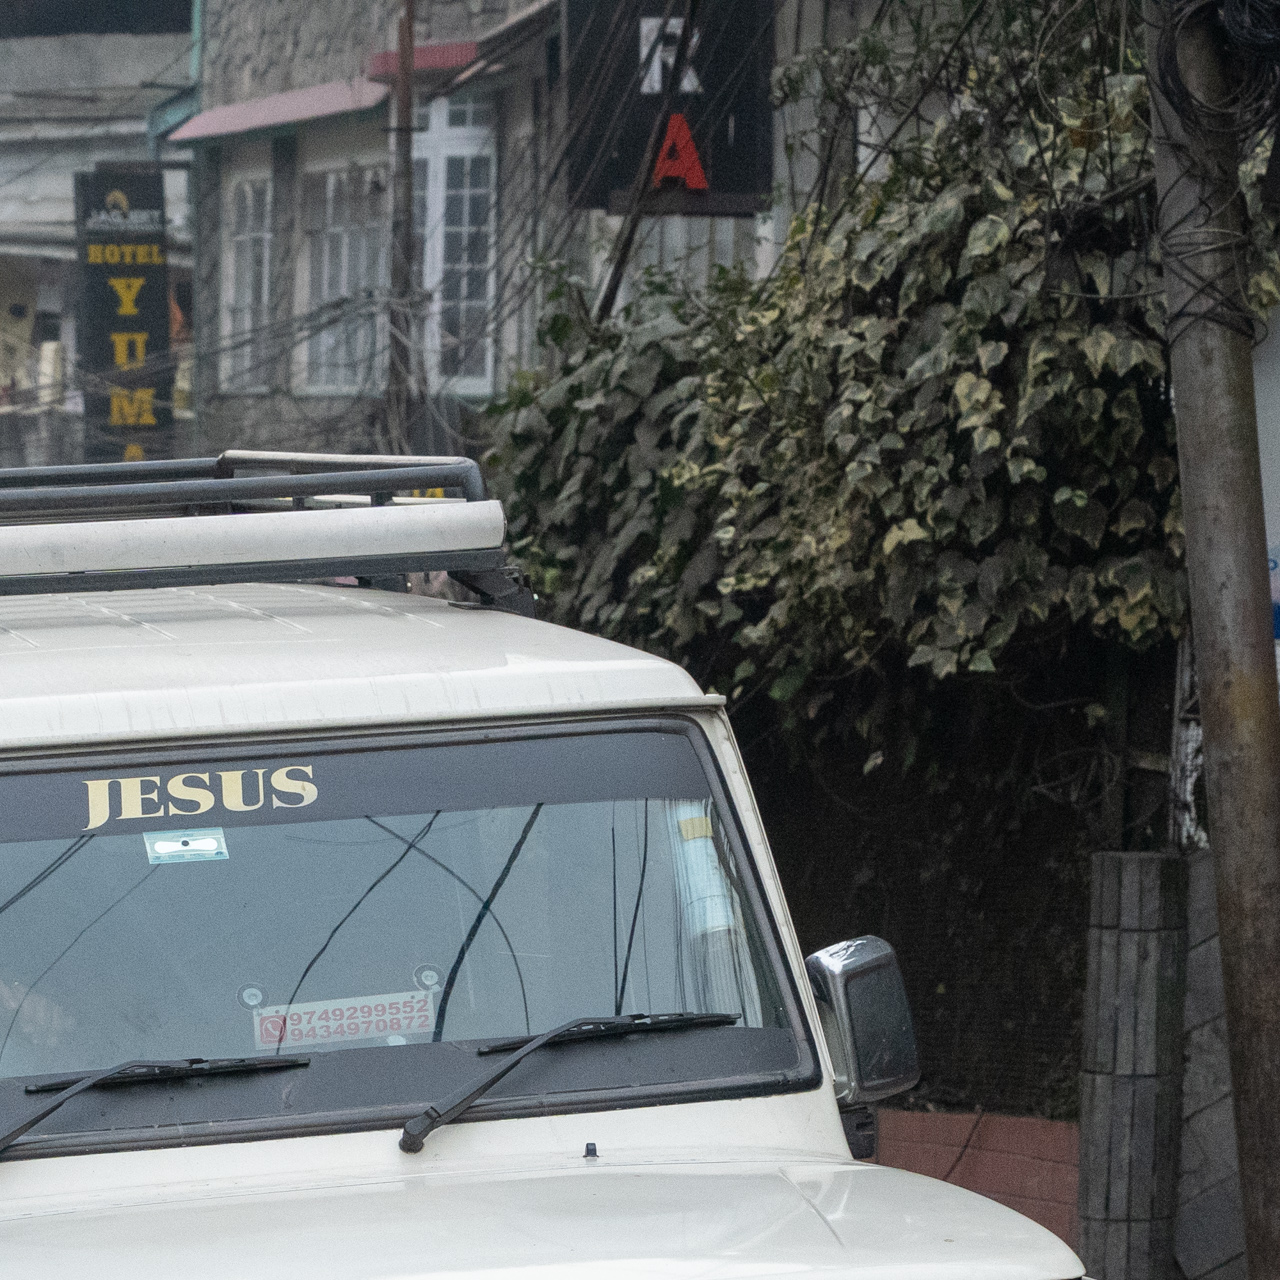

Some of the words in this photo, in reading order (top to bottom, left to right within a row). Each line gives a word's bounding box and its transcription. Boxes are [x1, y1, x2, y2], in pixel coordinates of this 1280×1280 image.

[88, 244, 164, 265] HOTEL
[82, 765, 318, 830] JESUS
[289, 998, 429, 1027] 9749299552
[290, 1014, 430, 1042] 9434970872
